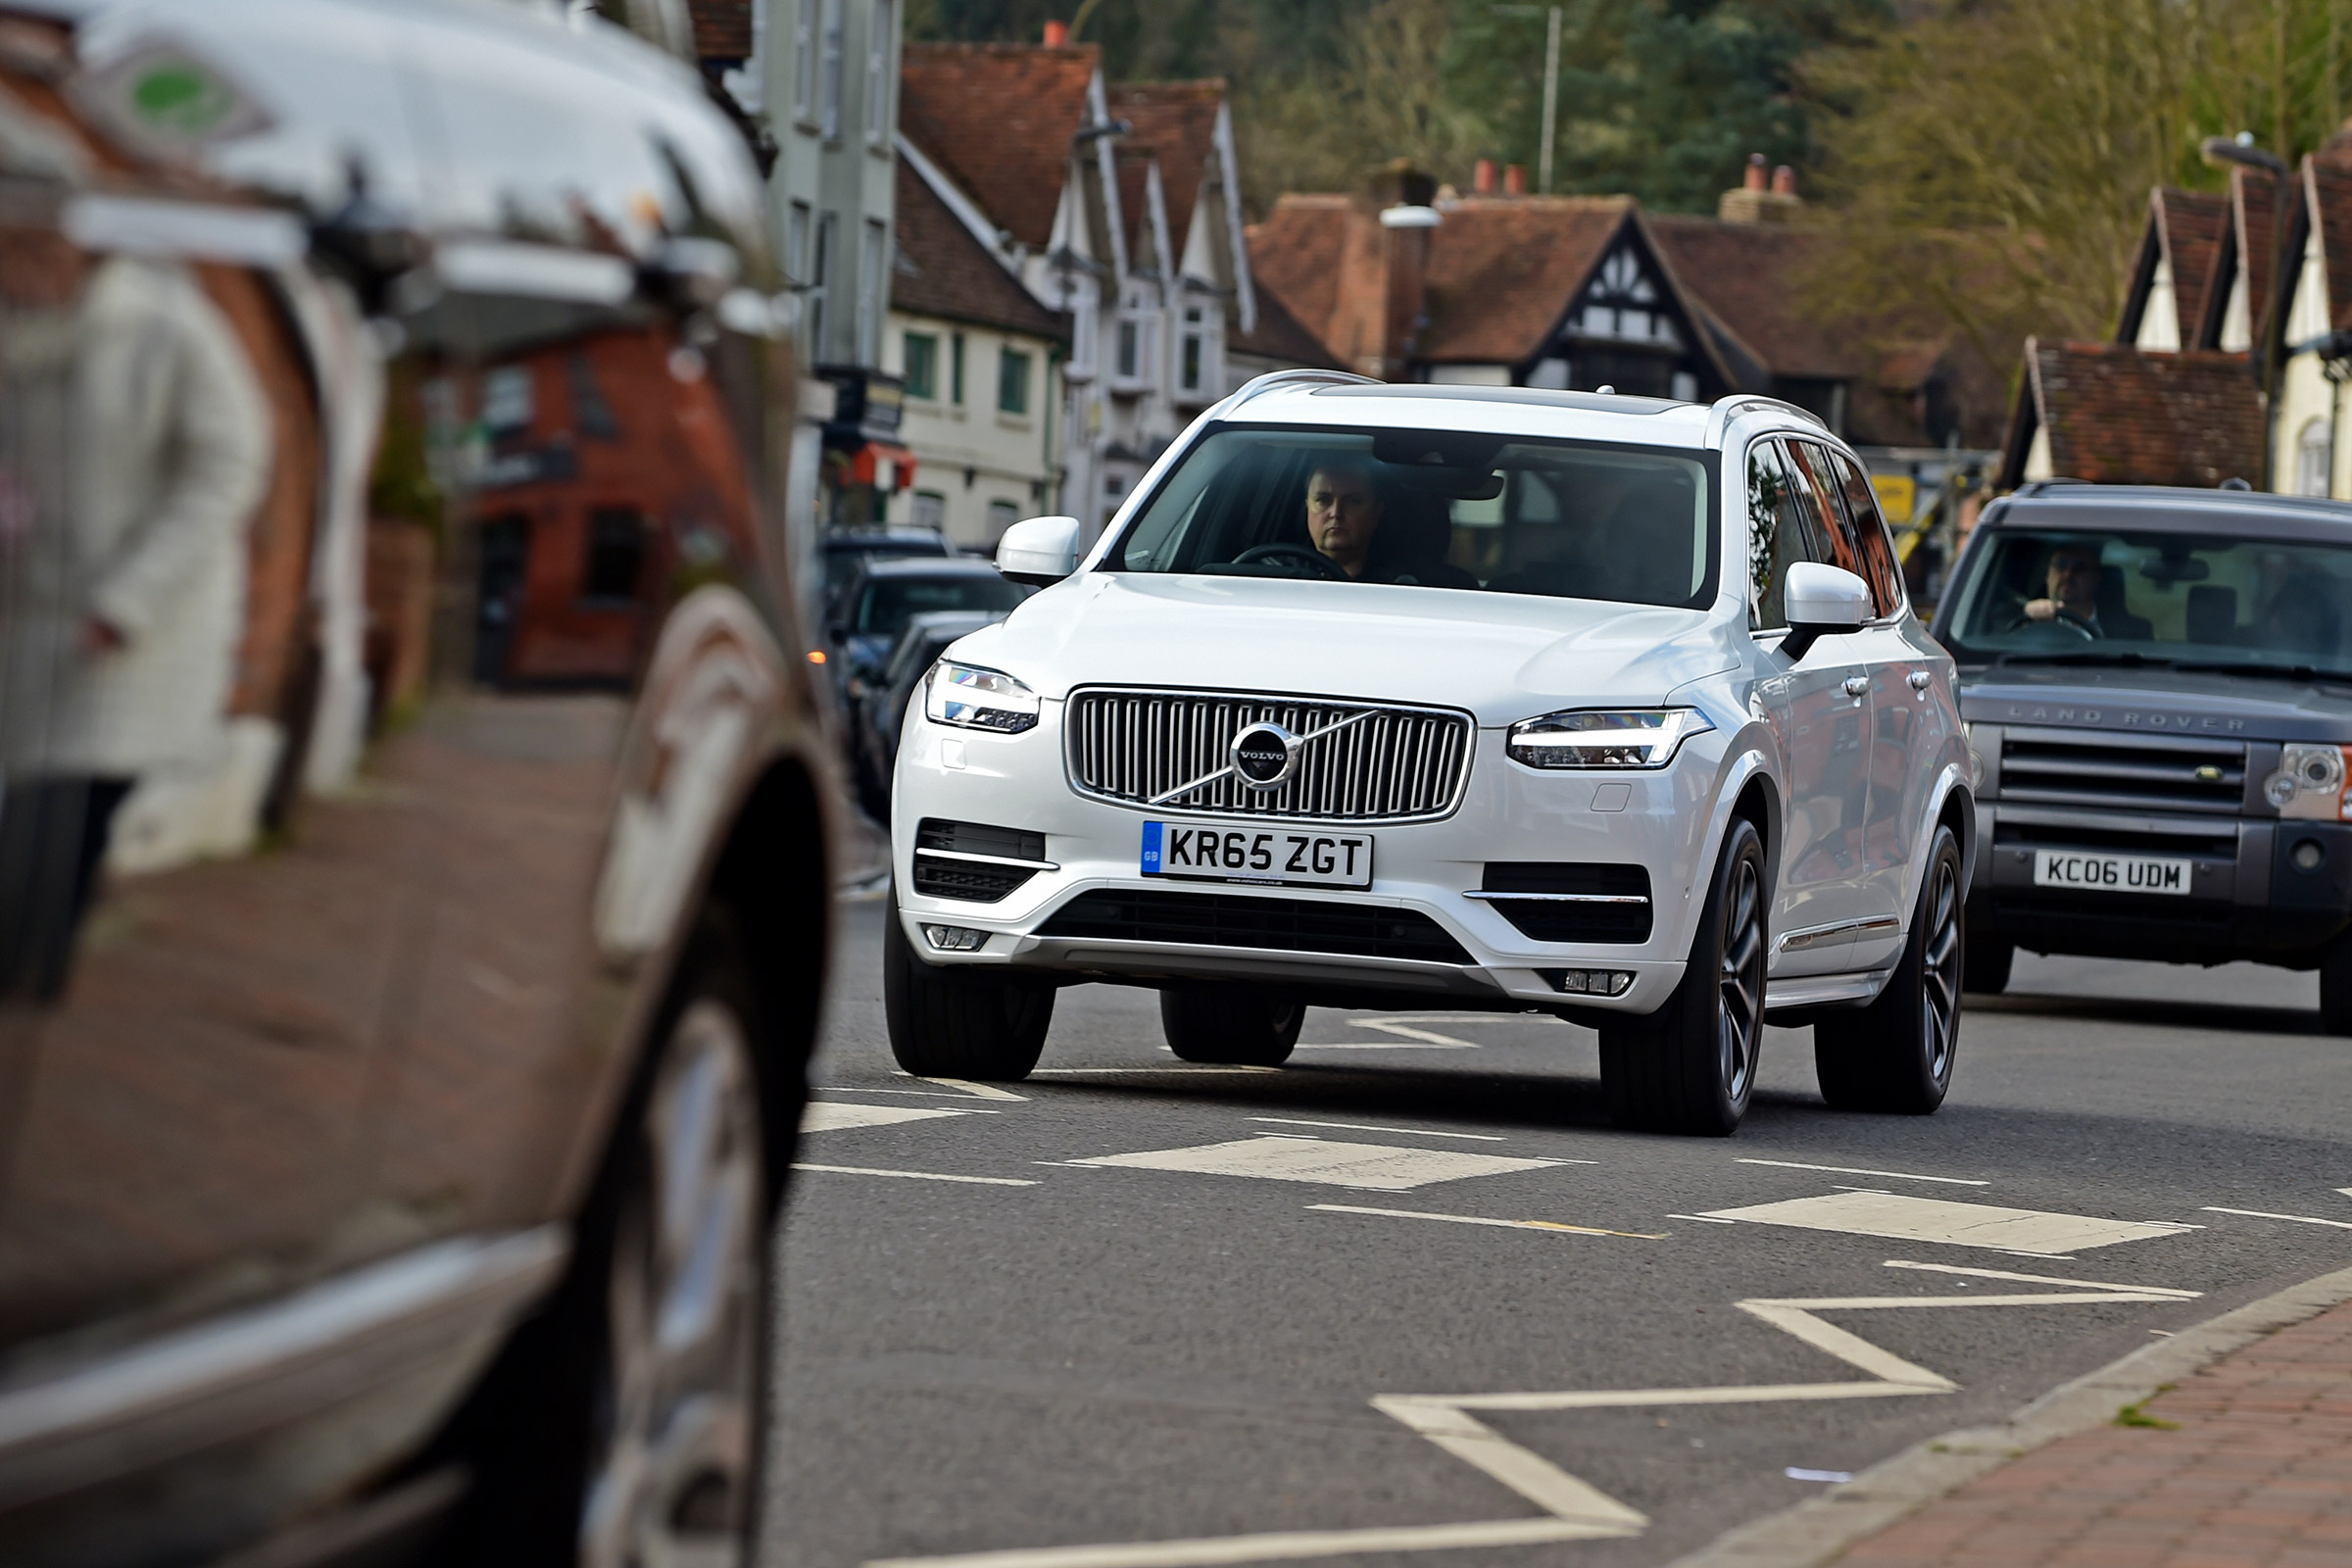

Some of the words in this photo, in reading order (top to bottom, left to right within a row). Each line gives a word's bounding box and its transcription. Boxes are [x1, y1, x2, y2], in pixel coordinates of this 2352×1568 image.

[2008, 706, 2102, 722] LAND
[2124, 712, 2245, 731] ROVER
[1240, 751, 1285, 761] VOLVO
[1144, 851, 1158, 862] GB
[1169, 828, 1274, 870] KR65
[1285, 835, 1363, 876] ZGT
[2048, 857, 2118, 885] KC06
[2128, 862, 2180, 888] UDM
